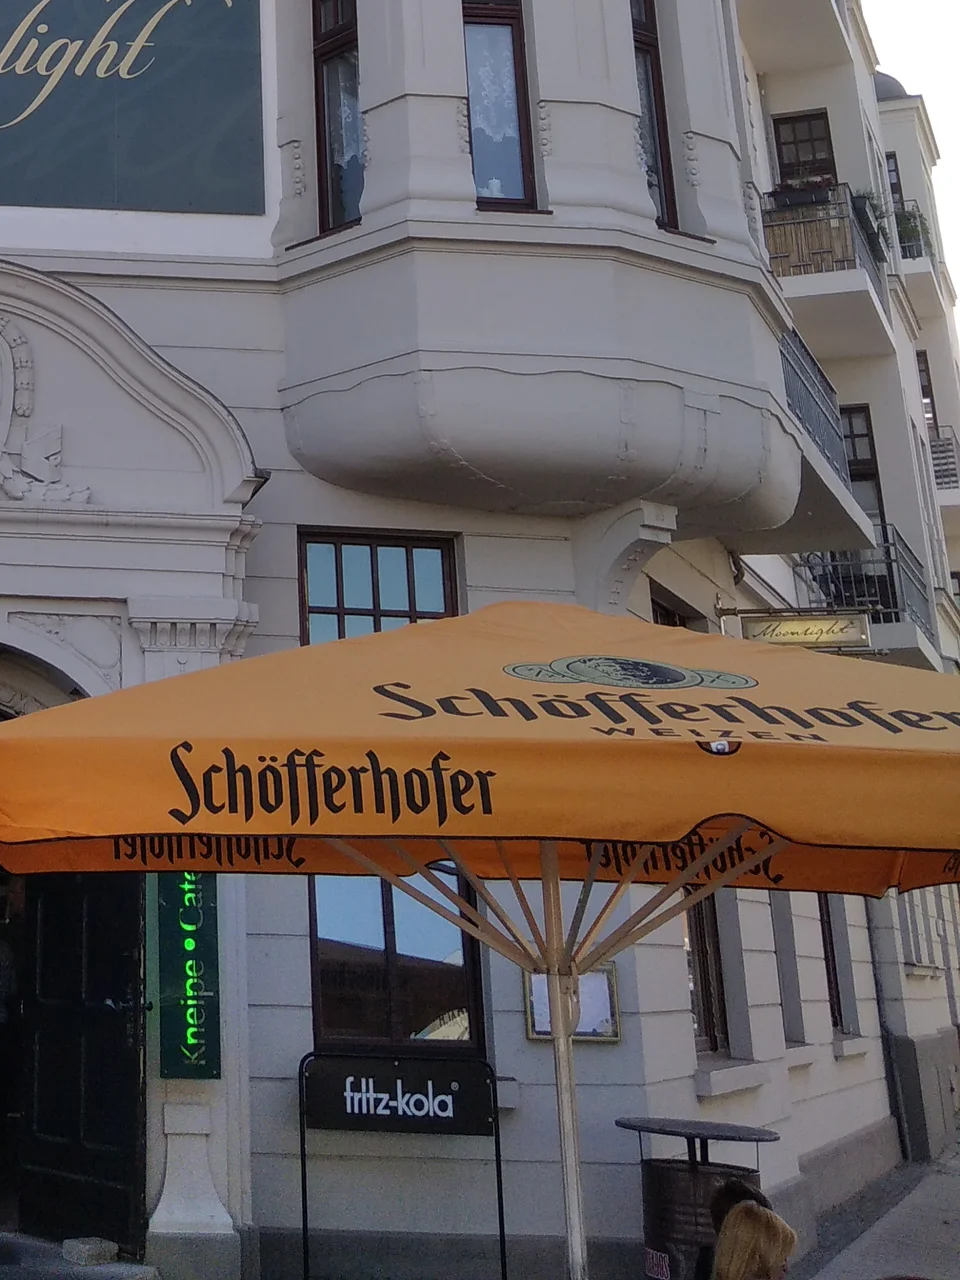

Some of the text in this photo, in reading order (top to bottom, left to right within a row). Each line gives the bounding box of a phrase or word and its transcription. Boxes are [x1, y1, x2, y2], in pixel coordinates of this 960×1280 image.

[752, 620, 857, 641] Moonlight
[589, 726, 828, 742] WEIZEN
[168, 740, 497, 828] Schöfferhofer
[180, 959, 214, 1066] Kneipe
[344, 1076, 453, 1118] fritz-kola
